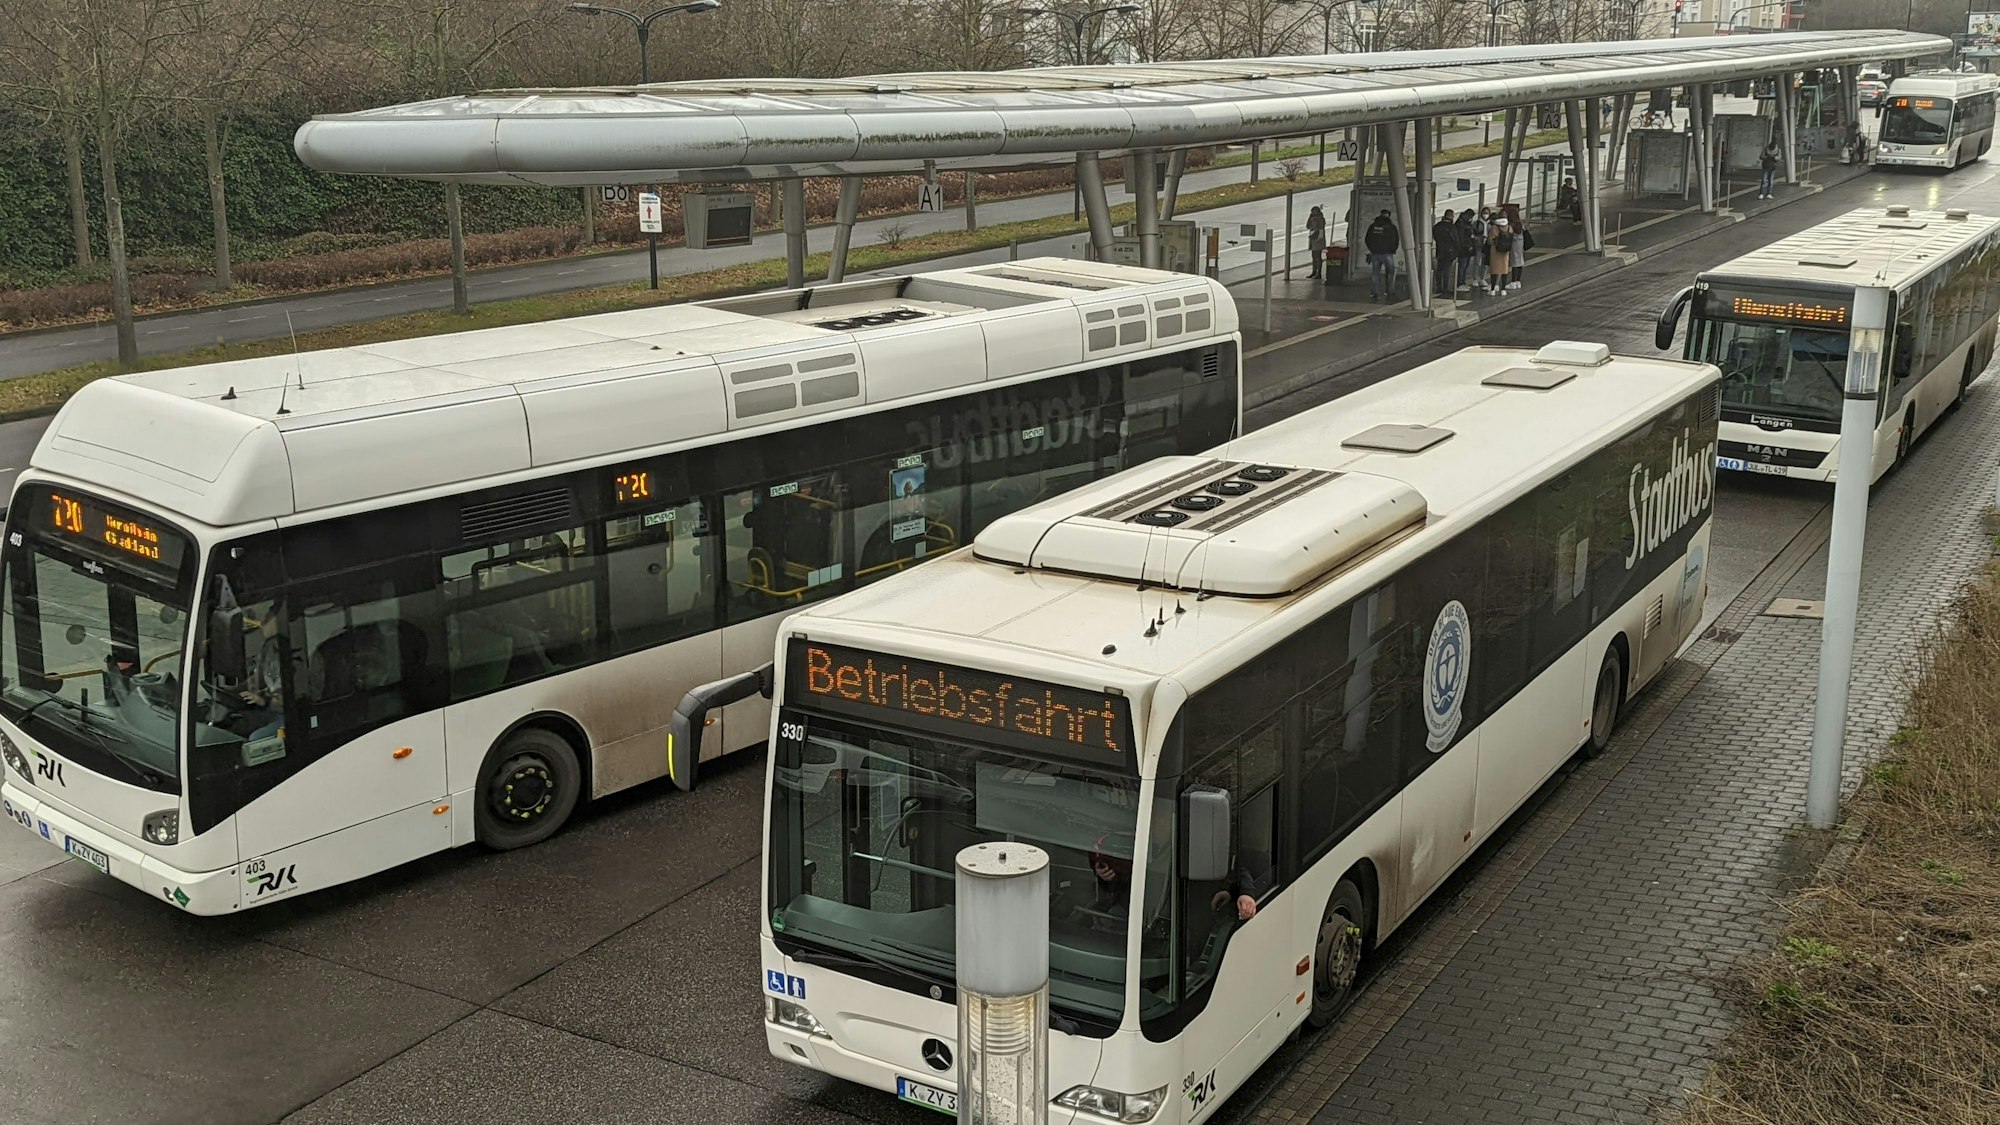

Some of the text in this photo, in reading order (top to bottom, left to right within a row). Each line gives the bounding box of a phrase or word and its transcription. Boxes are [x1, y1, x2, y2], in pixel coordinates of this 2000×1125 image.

[1544, 113, 1560, 129] A3
[1339, 142, 1358, 161] A2
[920, 185, 941, 211] A1
[1696, 281, 1709, 290] 419
[1751, 414, 1793, 428] Langen
[1747, 444, 1788, 457] MAN
[1625, 427, 1714, 570] Stadtbus
[9, 531, 22, 547] 403
[807, 647, 1122, 752] Betriebsfahrt
[781, 721, 803, 742] 330
[91, 851, 105, 868] 403
[245, 859, 266, 876] 403
[909, 1083, 918, 1099] K
[927, 1088, 944, 1106] ZY
